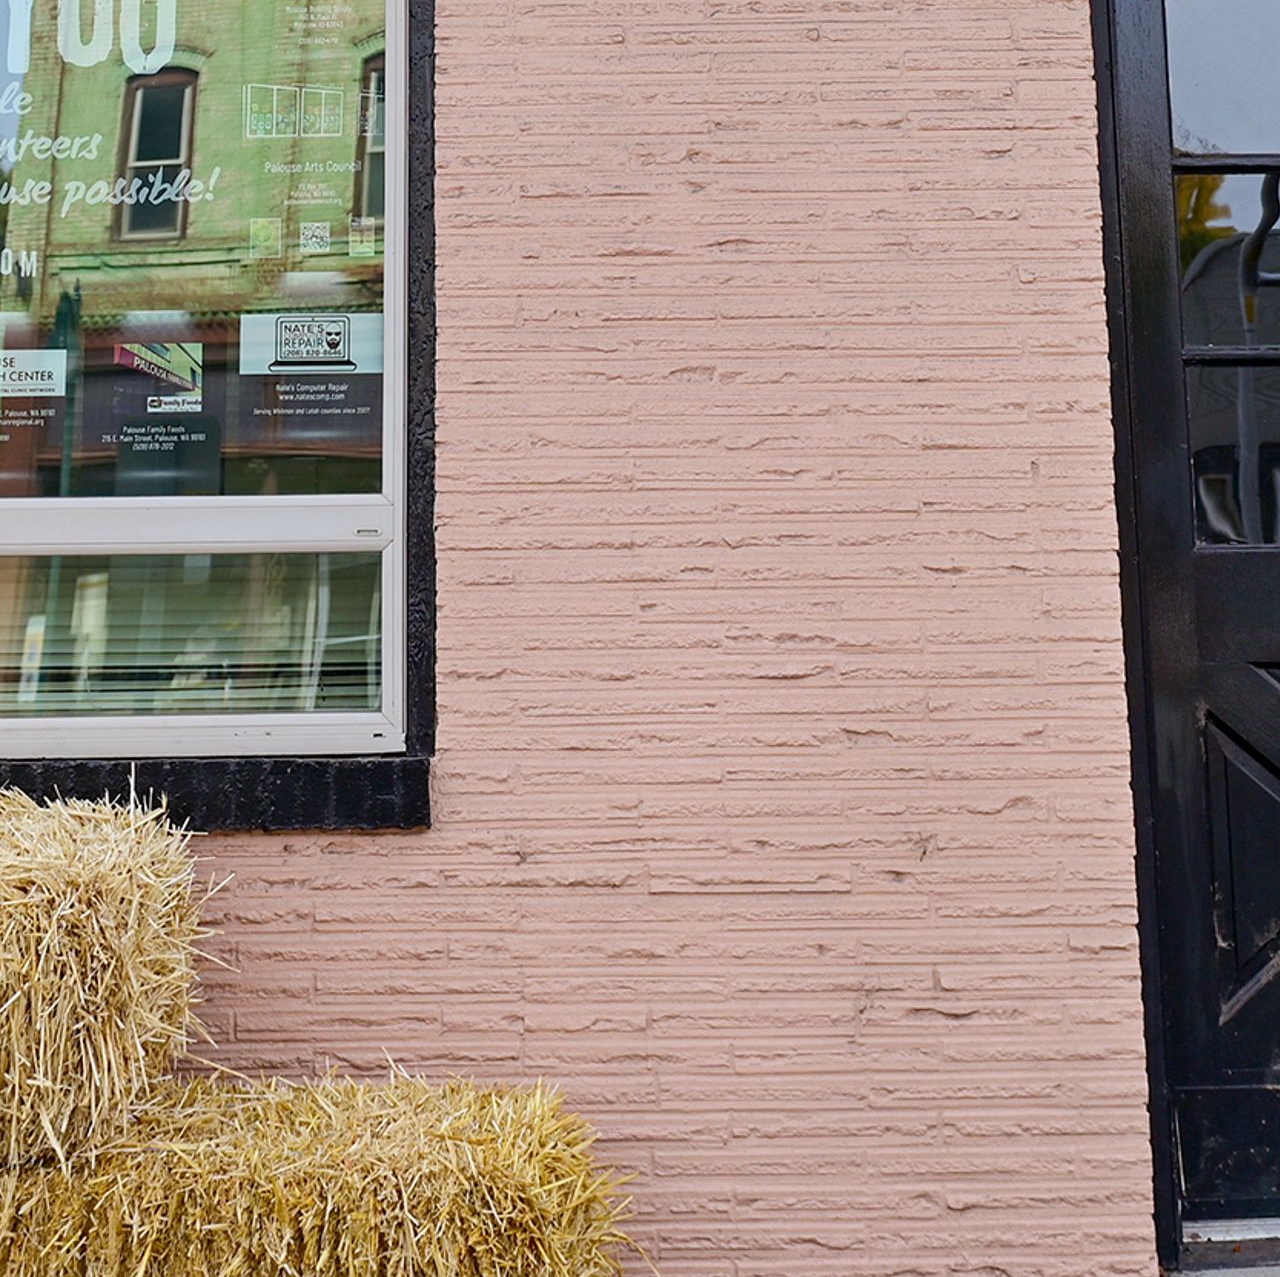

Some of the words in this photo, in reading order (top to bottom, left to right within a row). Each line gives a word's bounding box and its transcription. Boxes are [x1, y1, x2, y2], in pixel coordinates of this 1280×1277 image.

[264, 161, 302, 173] Palouse
[304, 161, 324, 172] Arts
[326, 160, 362, 172] Council
[61, 167, 220, 218] possible!
[283, 323, 325, 333] NATE'S
[283, 338, 325, 349] REPAIR
[9, 370, 55, 382] CENTER
[296, 383, 327, 393] Computer
[328, 383, 349, 392] Repair
